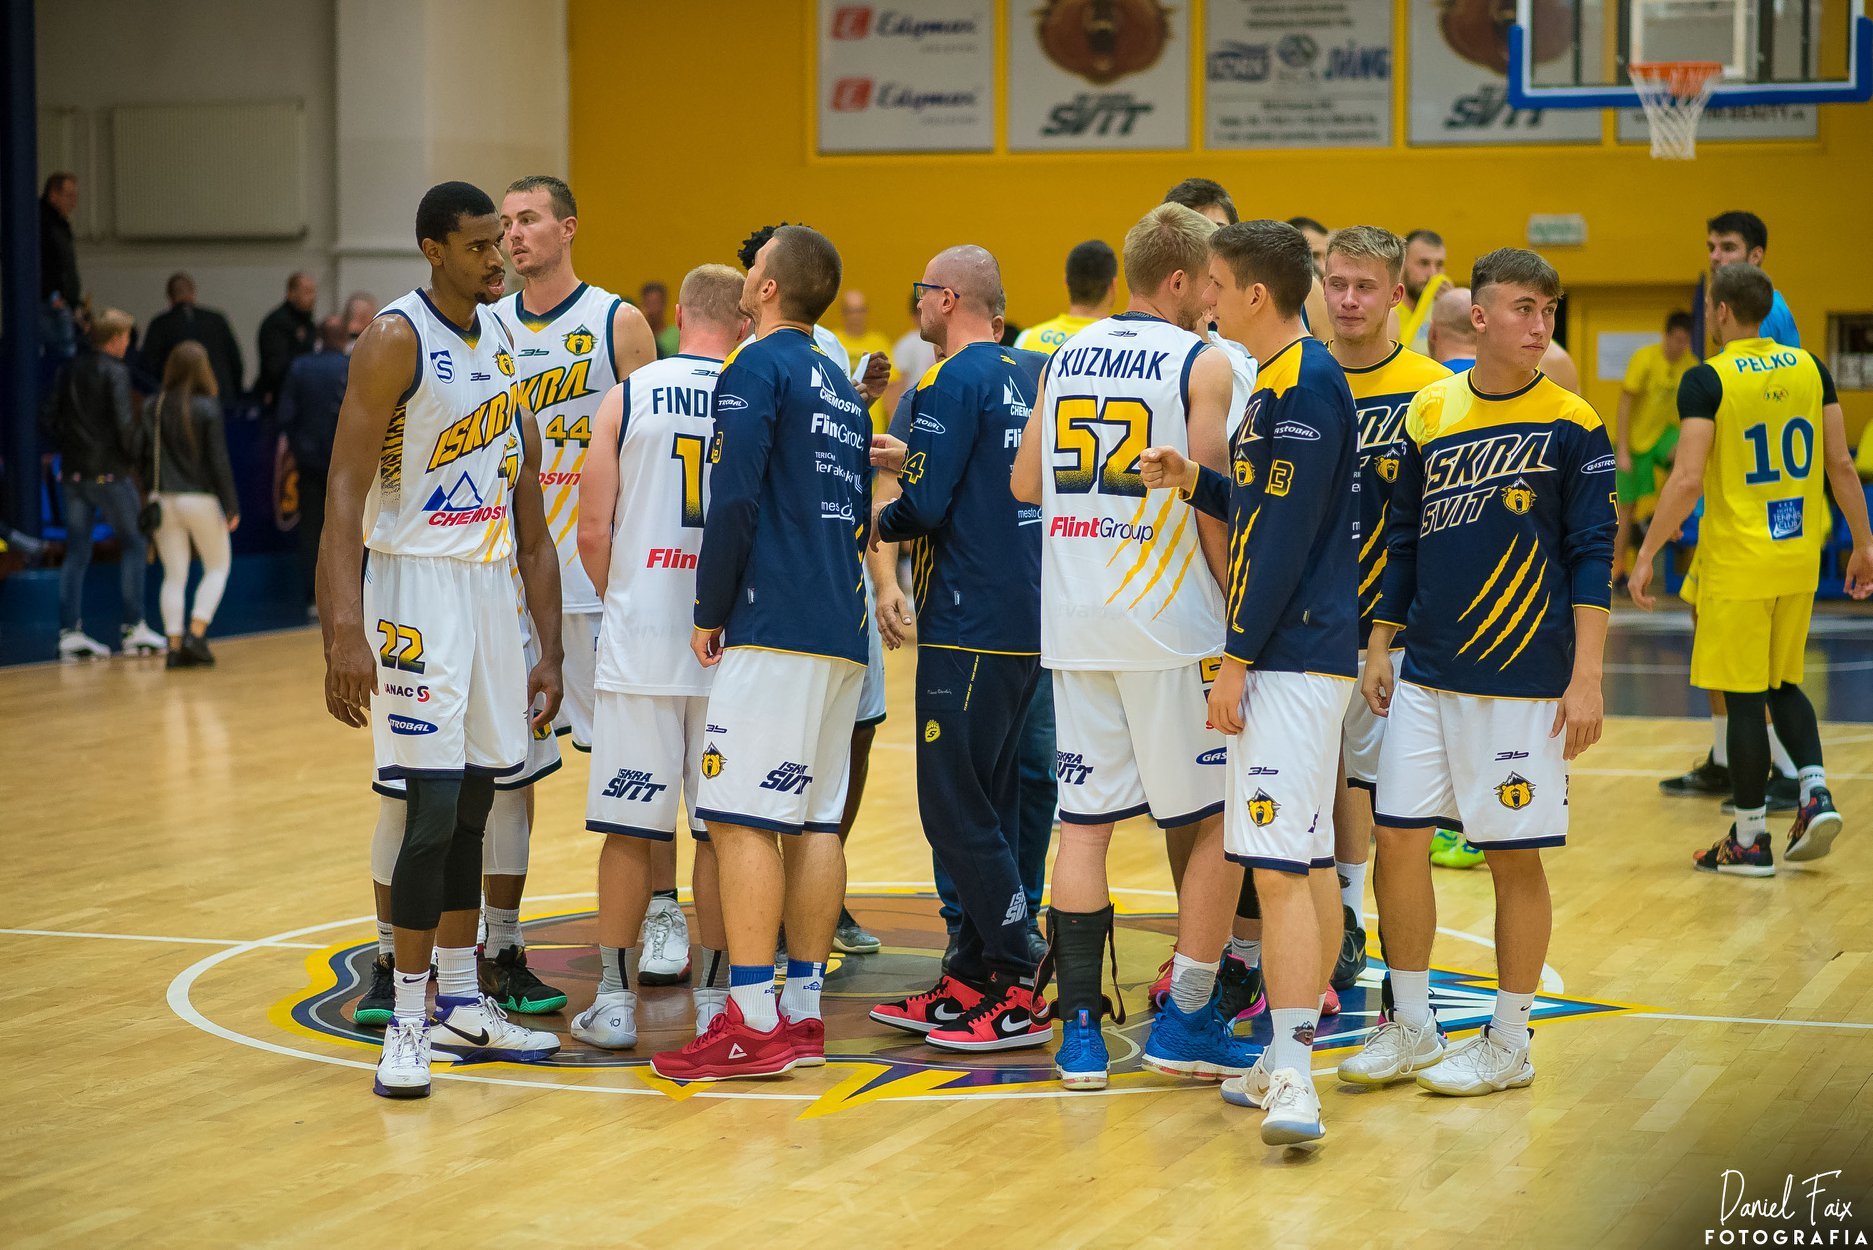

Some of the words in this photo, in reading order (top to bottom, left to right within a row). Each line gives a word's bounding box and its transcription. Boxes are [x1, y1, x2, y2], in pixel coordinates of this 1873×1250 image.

[1041, 329, 1068, 346] GO
[1057, 347, 1171, 380] KUZMIAK
[1734, 352, 1798, 374] PELKO
[652, 386, 716, 418] FIND
[1010, 404, 1033, 418] CHEMO
[425, 381, 519, 474] ISKRA
[545, 414, 592, 448] 44
[1052, 395, 1154, 498] 52
[1744, 416, 1815, 486] 10
[1422, 430, 1558, 502] ISKRA
[1420, 486, 1498, 538] SVIT
[1050, 516, 1154, 544] FlintGroup
[646, 548, 699, 569] Flin
[377, 618, 426, 675] 22
[1056, 750, 1083, 764] SKRA
[1202, 751, 1227, 763] GAS
[601, 777, 668, 803] SVIT
[617, 768, 654, 782] ISKRA
